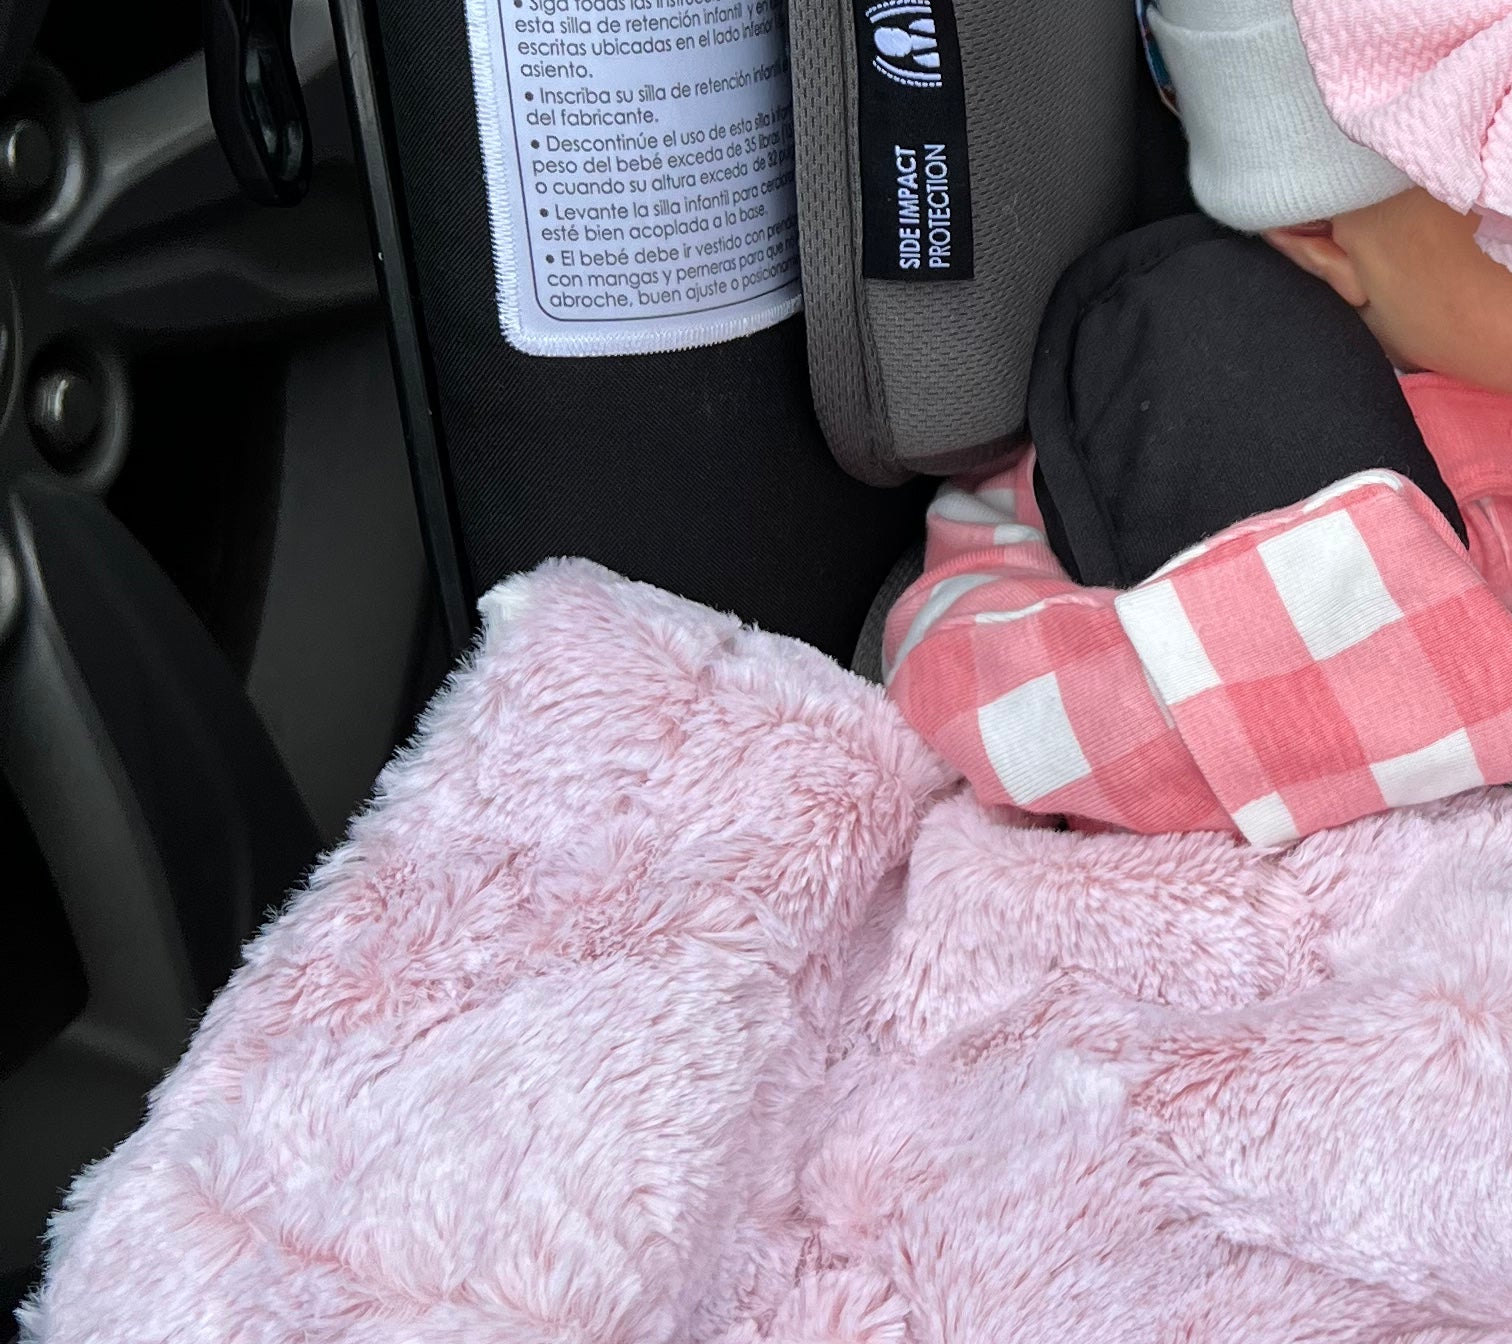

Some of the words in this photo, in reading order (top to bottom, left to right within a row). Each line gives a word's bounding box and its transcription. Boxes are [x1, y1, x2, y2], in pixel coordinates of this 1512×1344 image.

[520, 60, 593, 78] asiento.
[526, 109, 556, 126] del
[561, 108, 658, 126] fabricante.
[546, 132, 658, 152] Descontinúe
[894, 145, 920, 225] IMPACT
[555, 204, 628, 220] Levante
[924, 144, 951, 268] PROTECTION
[899, 228, 921, 269] SIDE
[550, 291, 633, 308] abroche,
[638, 290, 681, 305] buen
